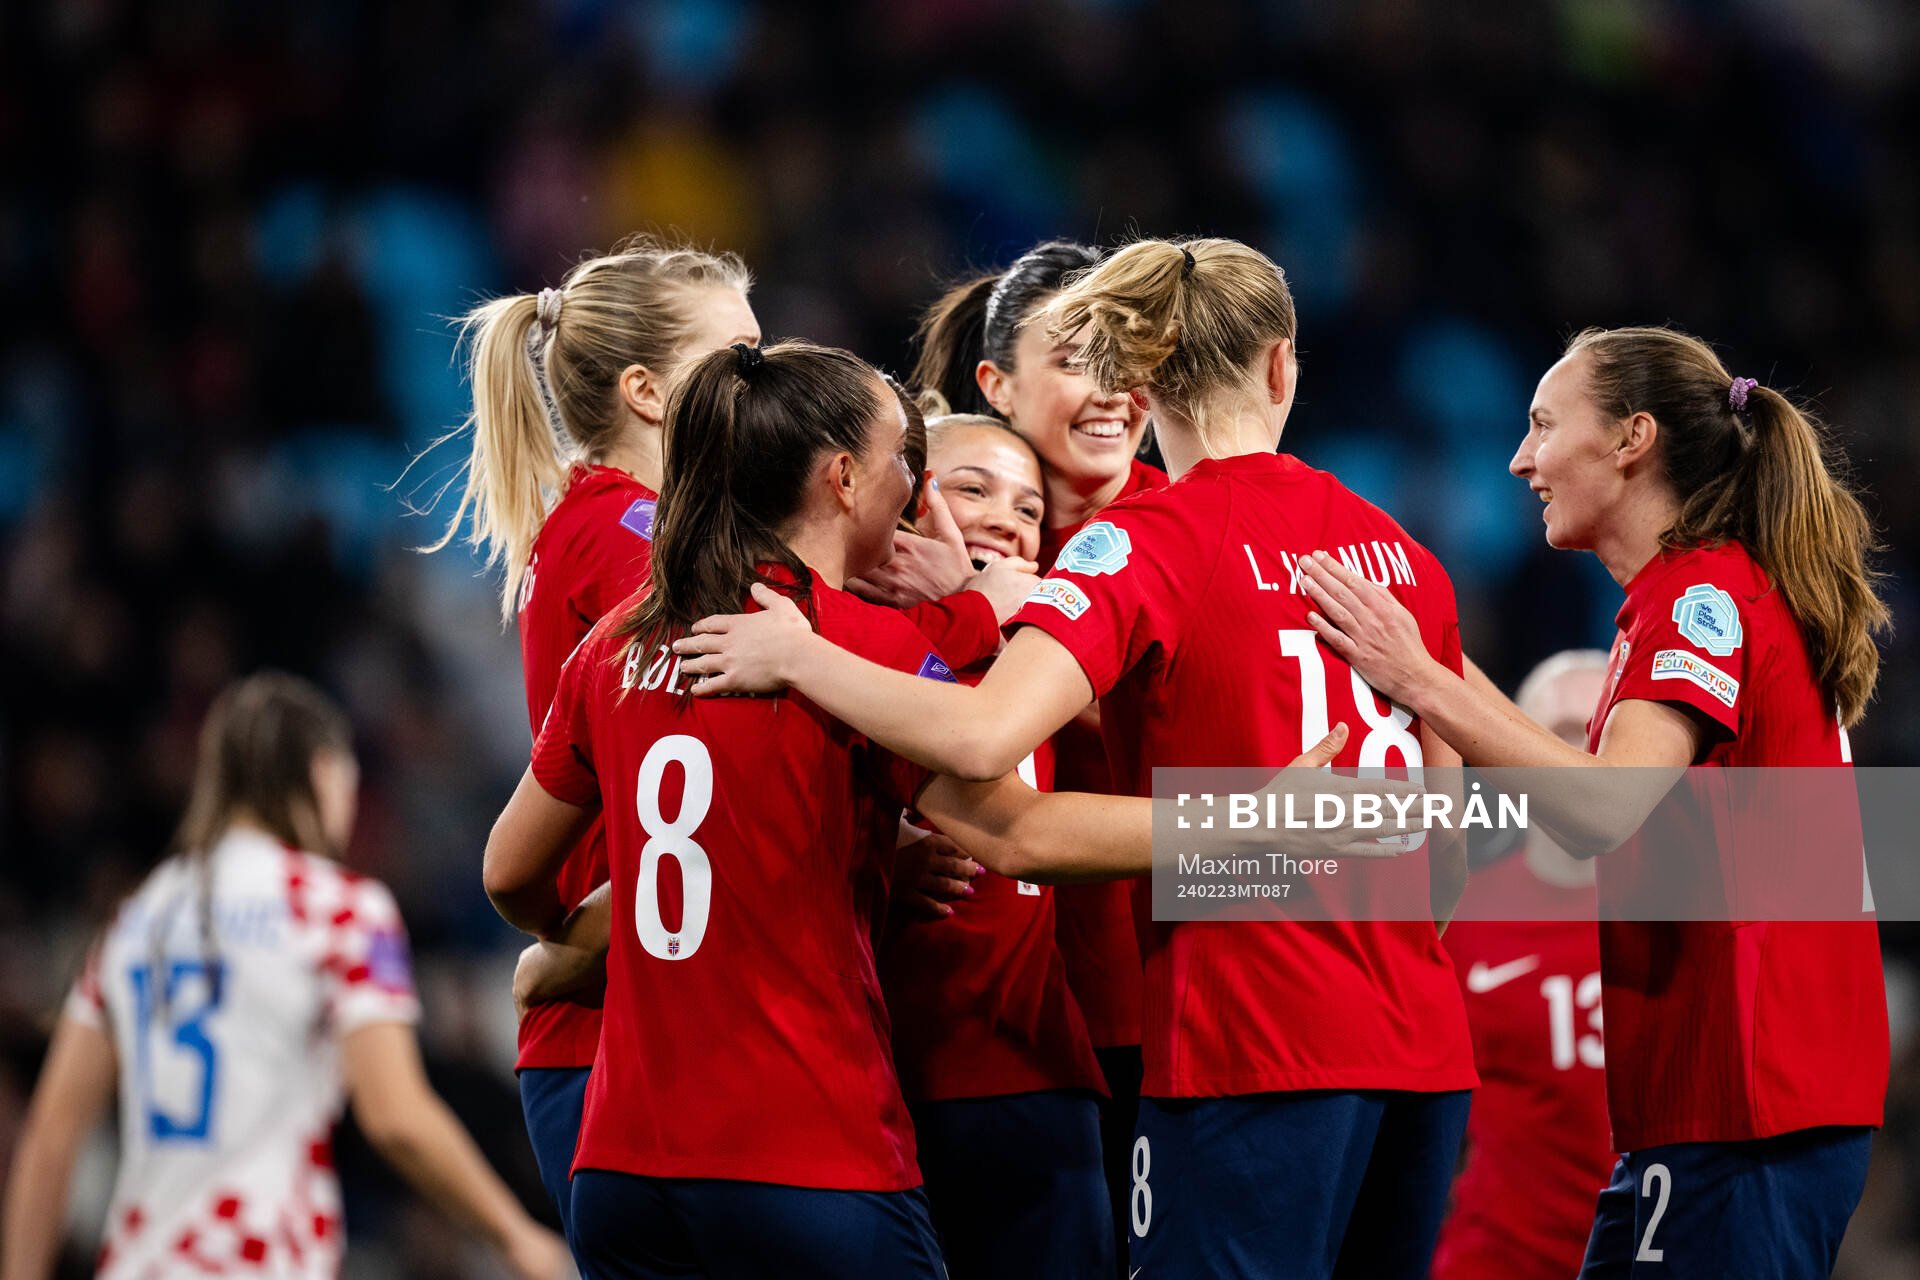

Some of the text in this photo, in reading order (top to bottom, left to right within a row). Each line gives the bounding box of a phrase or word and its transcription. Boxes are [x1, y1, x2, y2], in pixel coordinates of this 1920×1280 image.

[1243, 544, 1280, 591] L.
[1654, 659, 1736, 698] FOUNDATION
[1656, 651, 1677, 660] UEFA
[635, 734, 714, 961] 8
[1131, 1135, 1153, 1238] 8
[1635, 1162, 1672, 1263] 2
